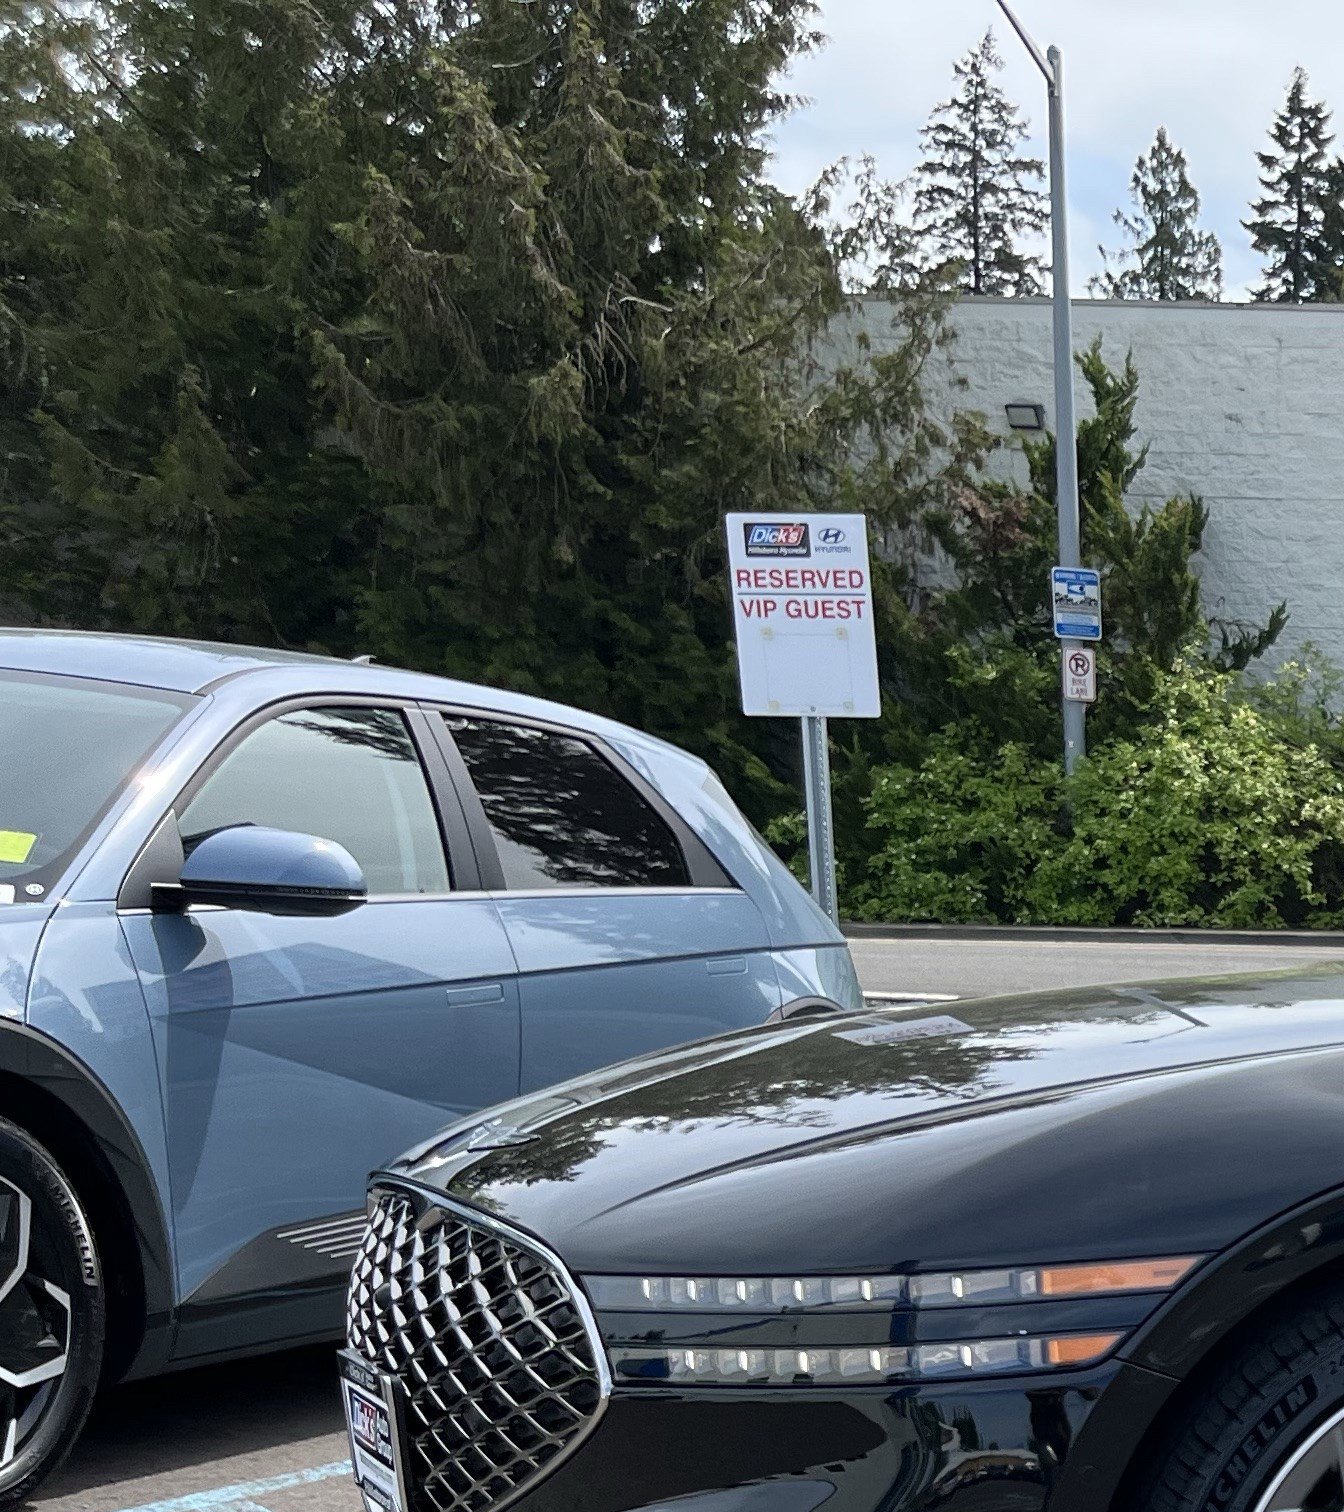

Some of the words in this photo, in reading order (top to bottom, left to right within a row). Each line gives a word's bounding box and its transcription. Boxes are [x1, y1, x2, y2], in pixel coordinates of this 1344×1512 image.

[736, 568, 864, 589] RESERVED
[740, 599, 777, 618] VIP
[785, 599, 866, 620] GUEST
[49, 1183, 95, 1279] MICHELIN
